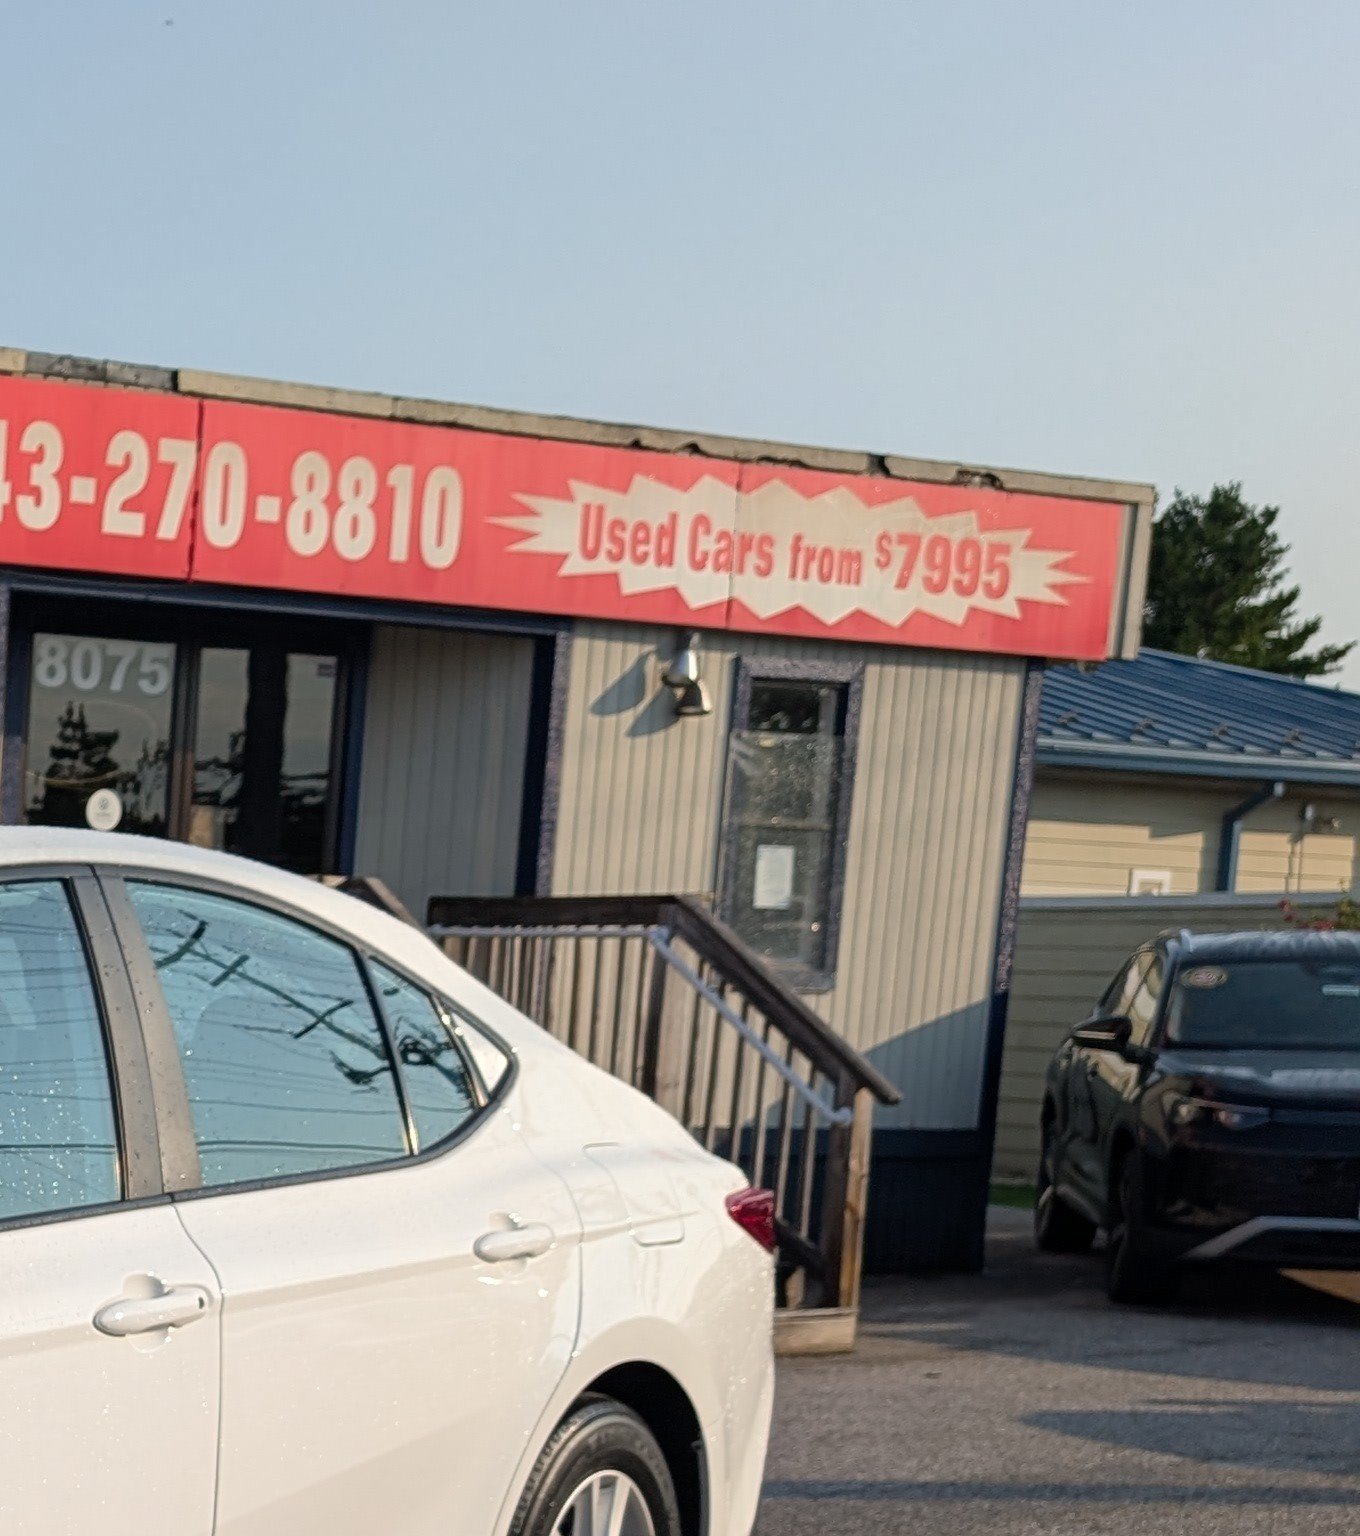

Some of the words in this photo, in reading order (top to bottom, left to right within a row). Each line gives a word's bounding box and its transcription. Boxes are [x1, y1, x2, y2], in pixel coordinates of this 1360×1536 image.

[580, 502, 677, 568] Used
[686, 512, 774, 578] Cars
[787, 533, 863, 587] from
[875, 530, 1012, 601] $7995
[34, 639, 171, 696] 8075
